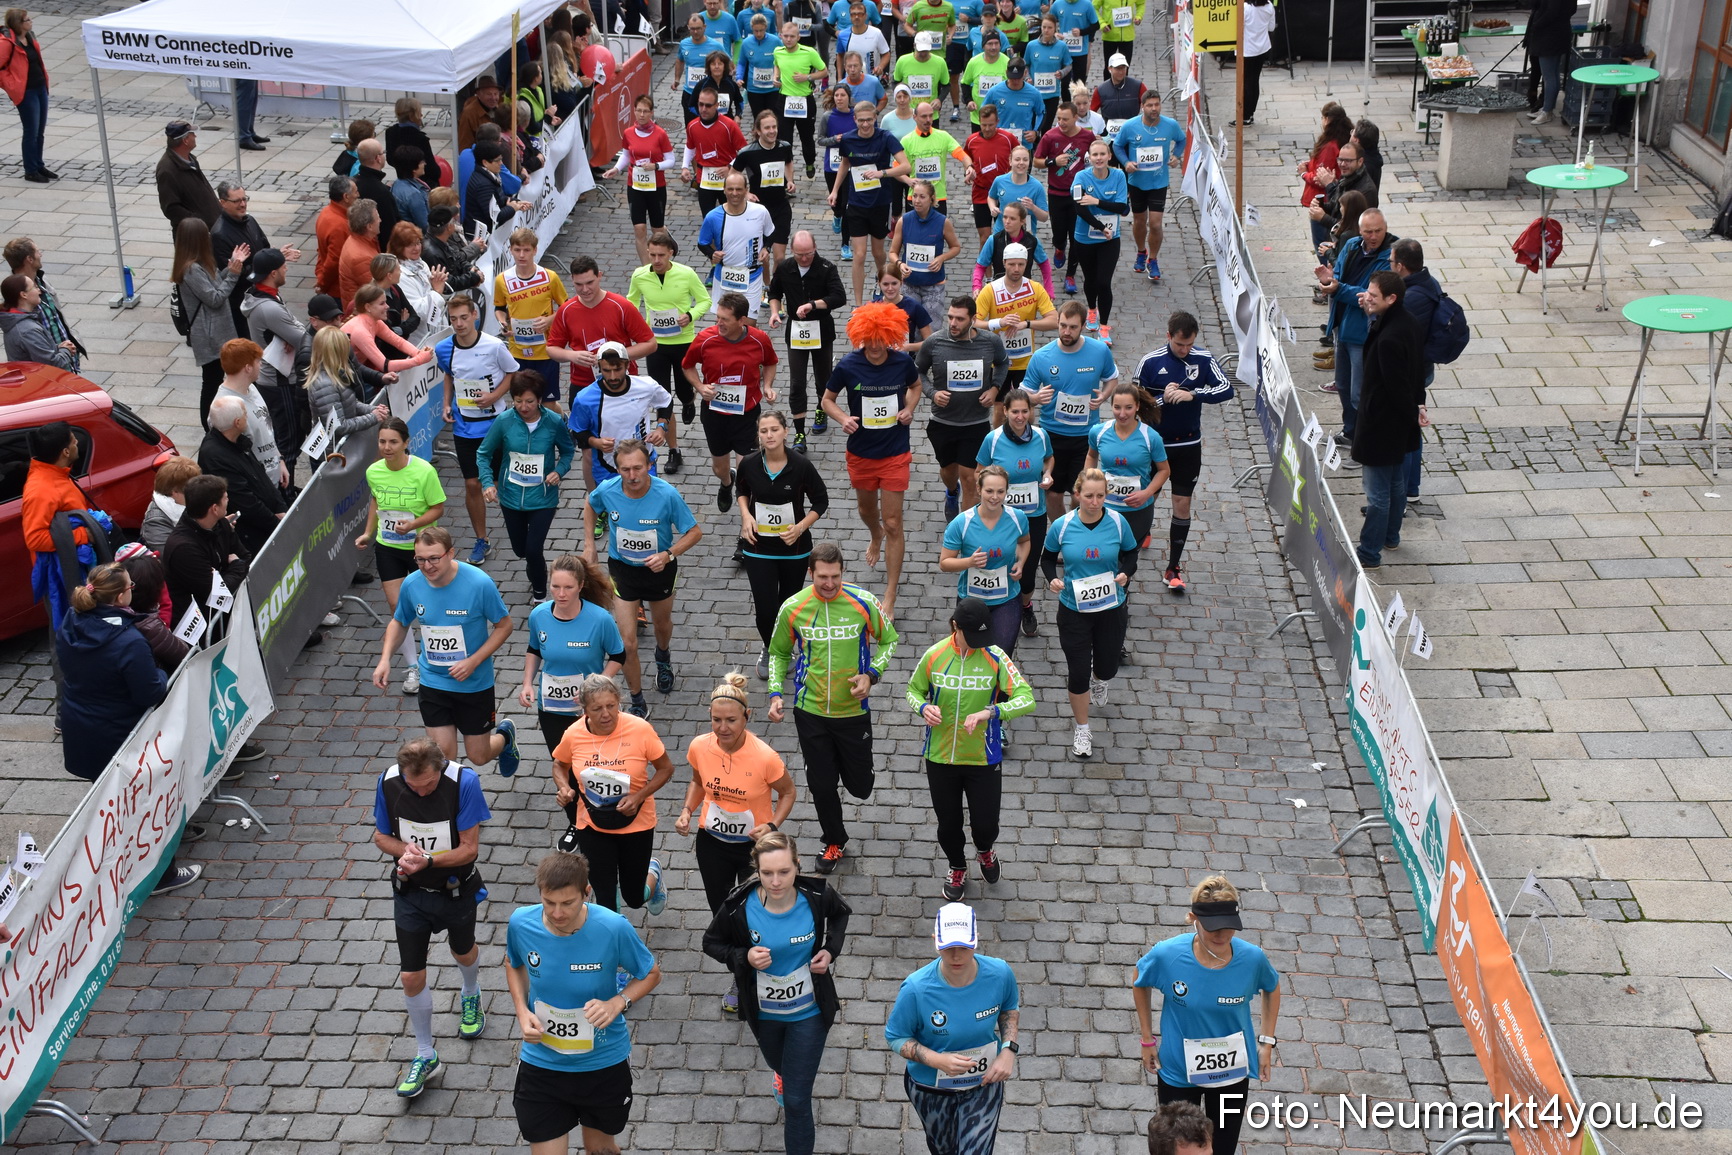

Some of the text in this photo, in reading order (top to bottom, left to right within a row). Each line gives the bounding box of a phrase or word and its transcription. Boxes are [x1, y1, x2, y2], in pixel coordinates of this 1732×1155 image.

[1208, 10, 1230, 22] lauf
[101, 30, 293, 59] BMW ConnectedDrive
[1065, 38, 1080, 46] 2233
[104, 48, 252, 71] Vernetzt, um frei zu sein.
[755, 73, 772, 81] 2463
[911, 83, 928, 91] 2483
[787, 102, 803, 110] 2035
[1139, 154, 1159, 163] 2487
[767, 170, 780, 179] 413
[918, 164, 938, 173] 2528
[637, 174, 649, 182] 125
[910, 252, 930, 263] 2731
[725, 272, 745, 283] 2238
[510, 286, 551, 303] MAX BÖGL
[996, 298, 1038, 315] MAX BÖGL
[653, 317, 676, 327] 2998
[799, 330, 811, 339] 85
[1005, 338, 1028, 348] 2610
[952, 370, 978, 381] 2524
[715, 391, 740, 403] 2534
[874, 407, 888, 416] 35
[1060, 403, 1085, 414] 2072
[309, 435, 323, 453] swn
[514, 461, 538, 474] 2485
[1108, 484, 1135, 495] 2402
[1006, 492, 1032, 505] 2011
[768, 514, 782, 524] 20
[622, 538, 652, 550] 2996
[973, 576, 1000, 589] 2451
[257, 549, 306, 642] BOCK
[1080, 584, 1111, 601] 2370
[184, 616, 200, 638] swn
[799, 623, 861, 641] BOCK
[428, 637, 458, 651] 2792
[931, 671, 994, 691] BOCK
[547, 685, 579, 698] 2930
[584, 758, 626, 767] Atzenhofer
[587, 780, 623, 796] 2519
[705, 781, 747, 796] Atzenhofer
[711, 817, 747, 835] 2007
[790, 932, 815, 944] BOCK
[570, 963, 602, 971] BOCK
[765, 981, 804, 1000] 2207
[1218, 996, 1245, 1004] BOCK
[48, 976, 102, 1061] Service-Line:
[975, 1005, 1000, 1020] BOCK
[546, 1019, 579, 1038] 283
[1501, 998, 1525, 1047] Neumarkts
[1194, 1050, 1237, 1071] 2587
[952, 1077, 980, 1085] Michaela
[1208, 1073, 1230, 1081] Verena
